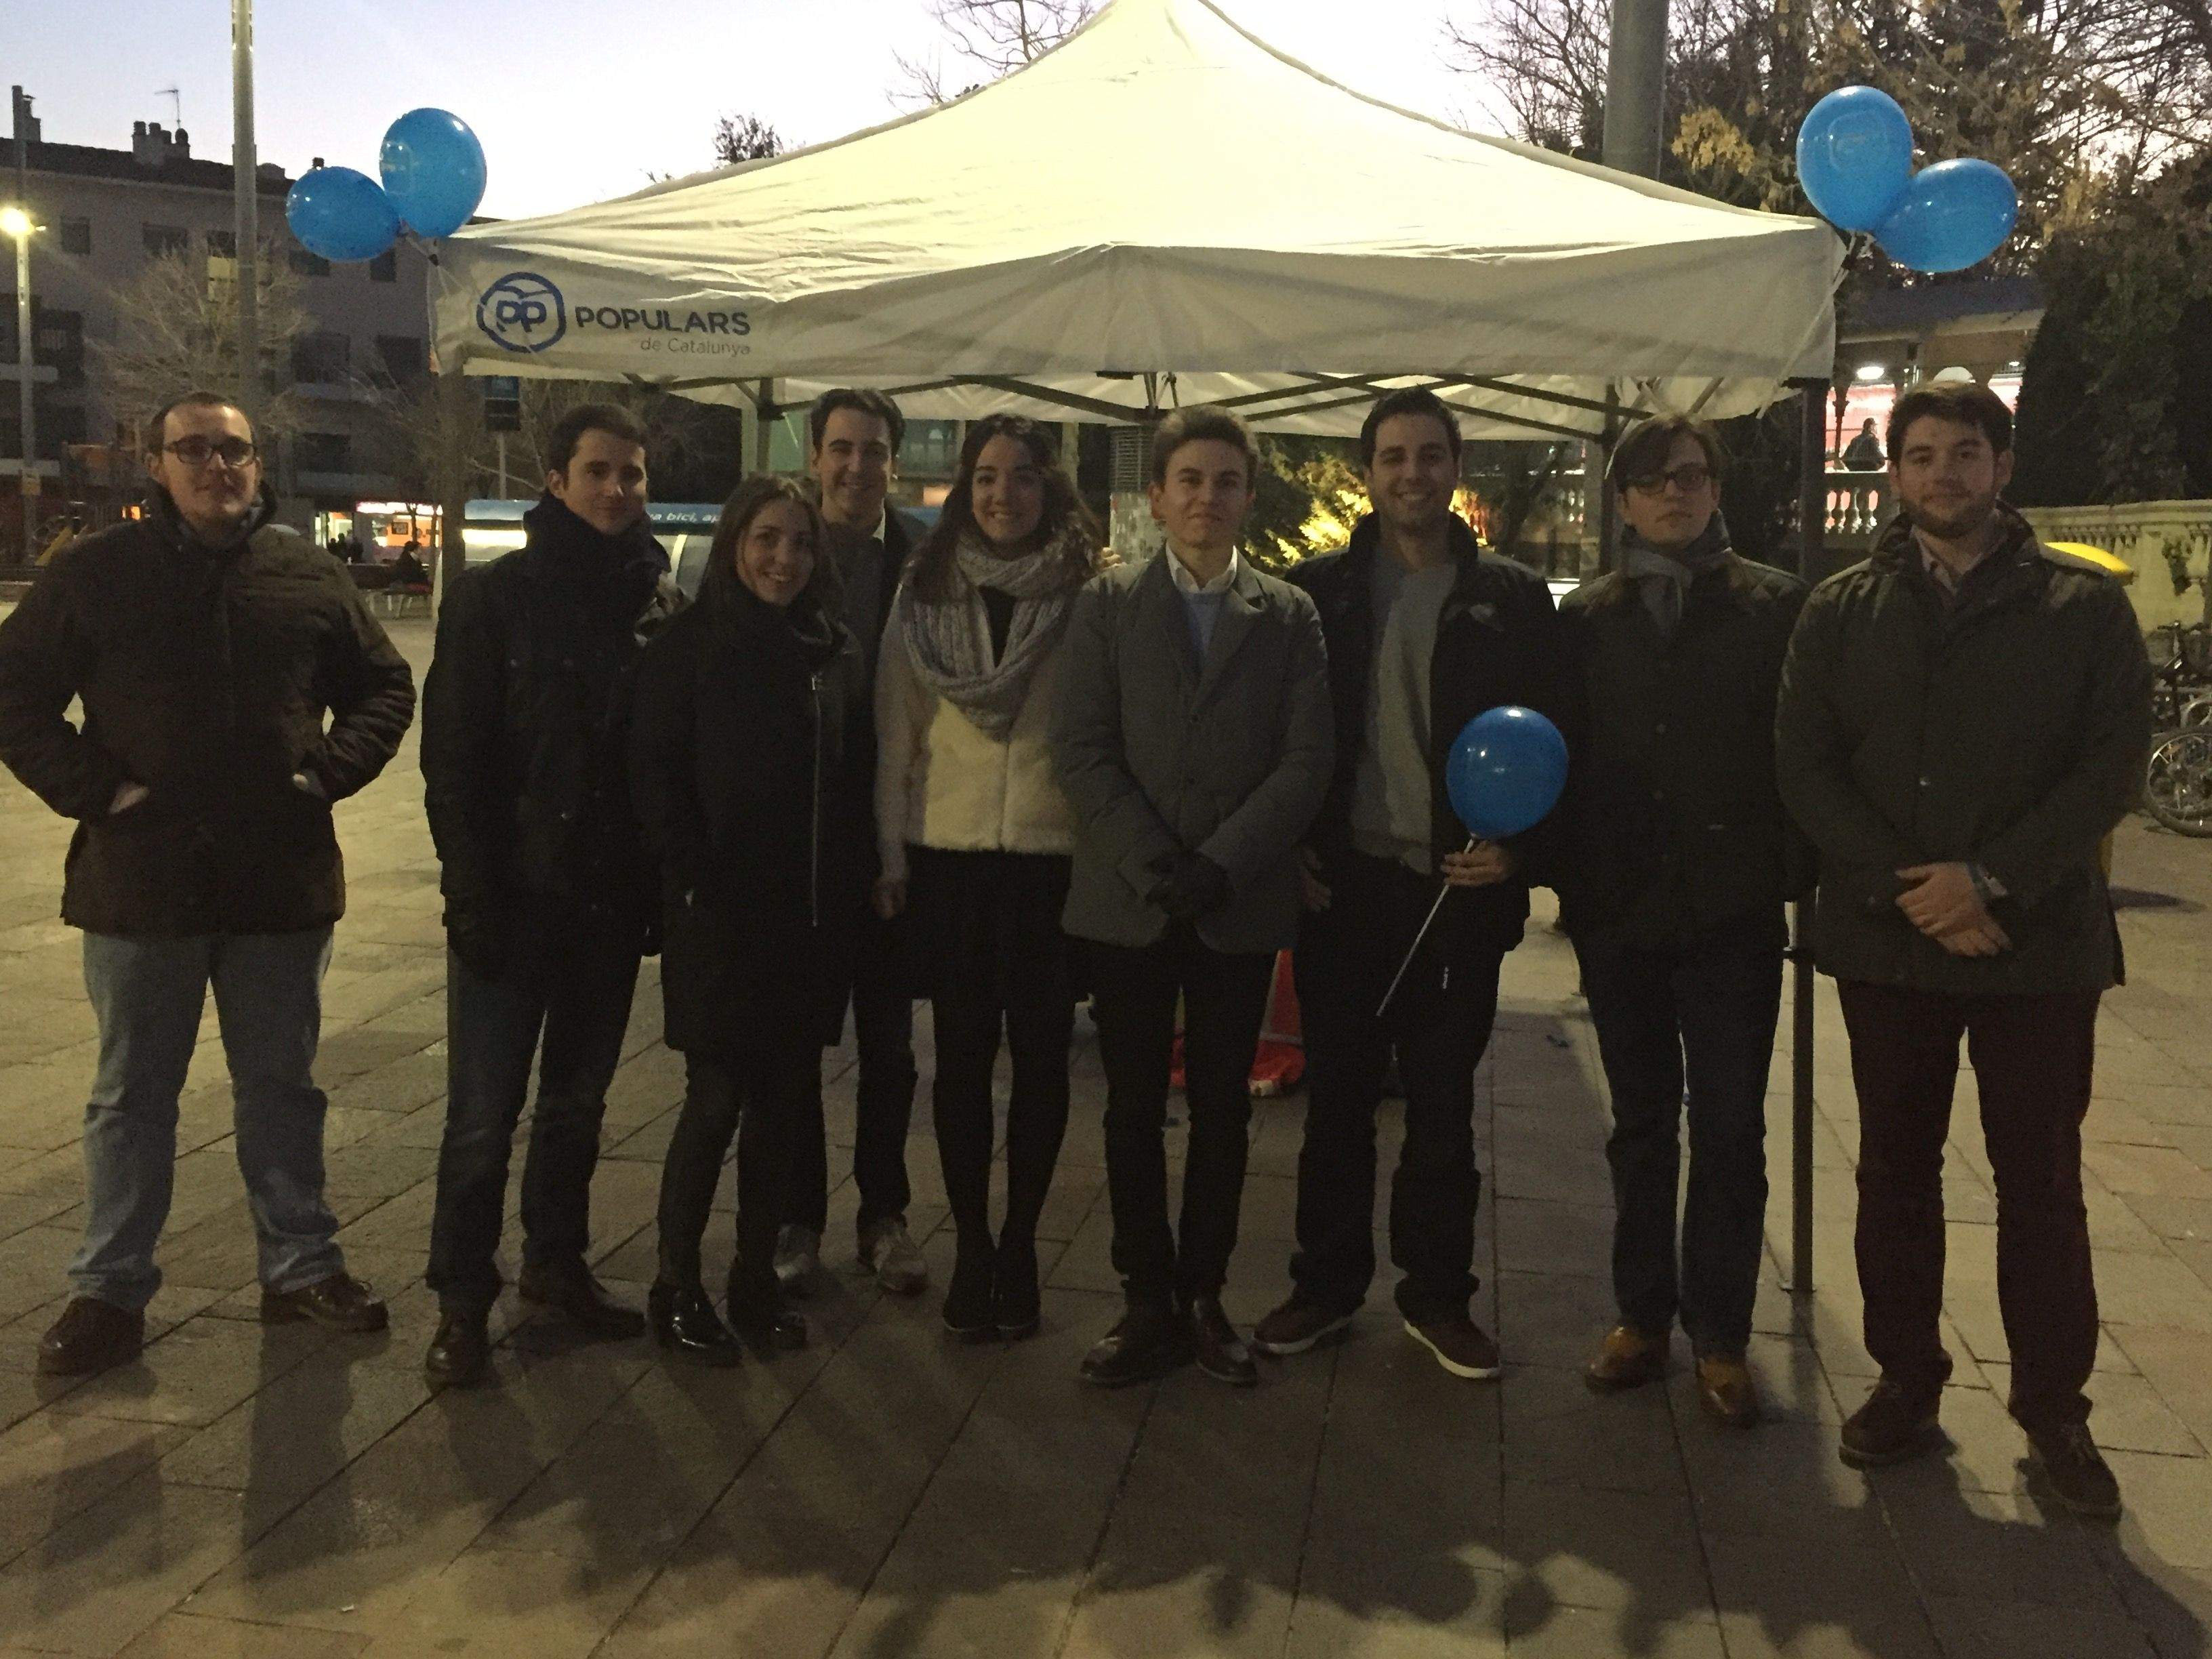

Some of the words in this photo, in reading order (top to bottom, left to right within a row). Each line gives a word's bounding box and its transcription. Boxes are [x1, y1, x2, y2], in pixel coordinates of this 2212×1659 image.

[575, 306, 751, 335] POPULARS
[640, 337, 661, 351] de
[668, 338, 750, 357] Catalunya
